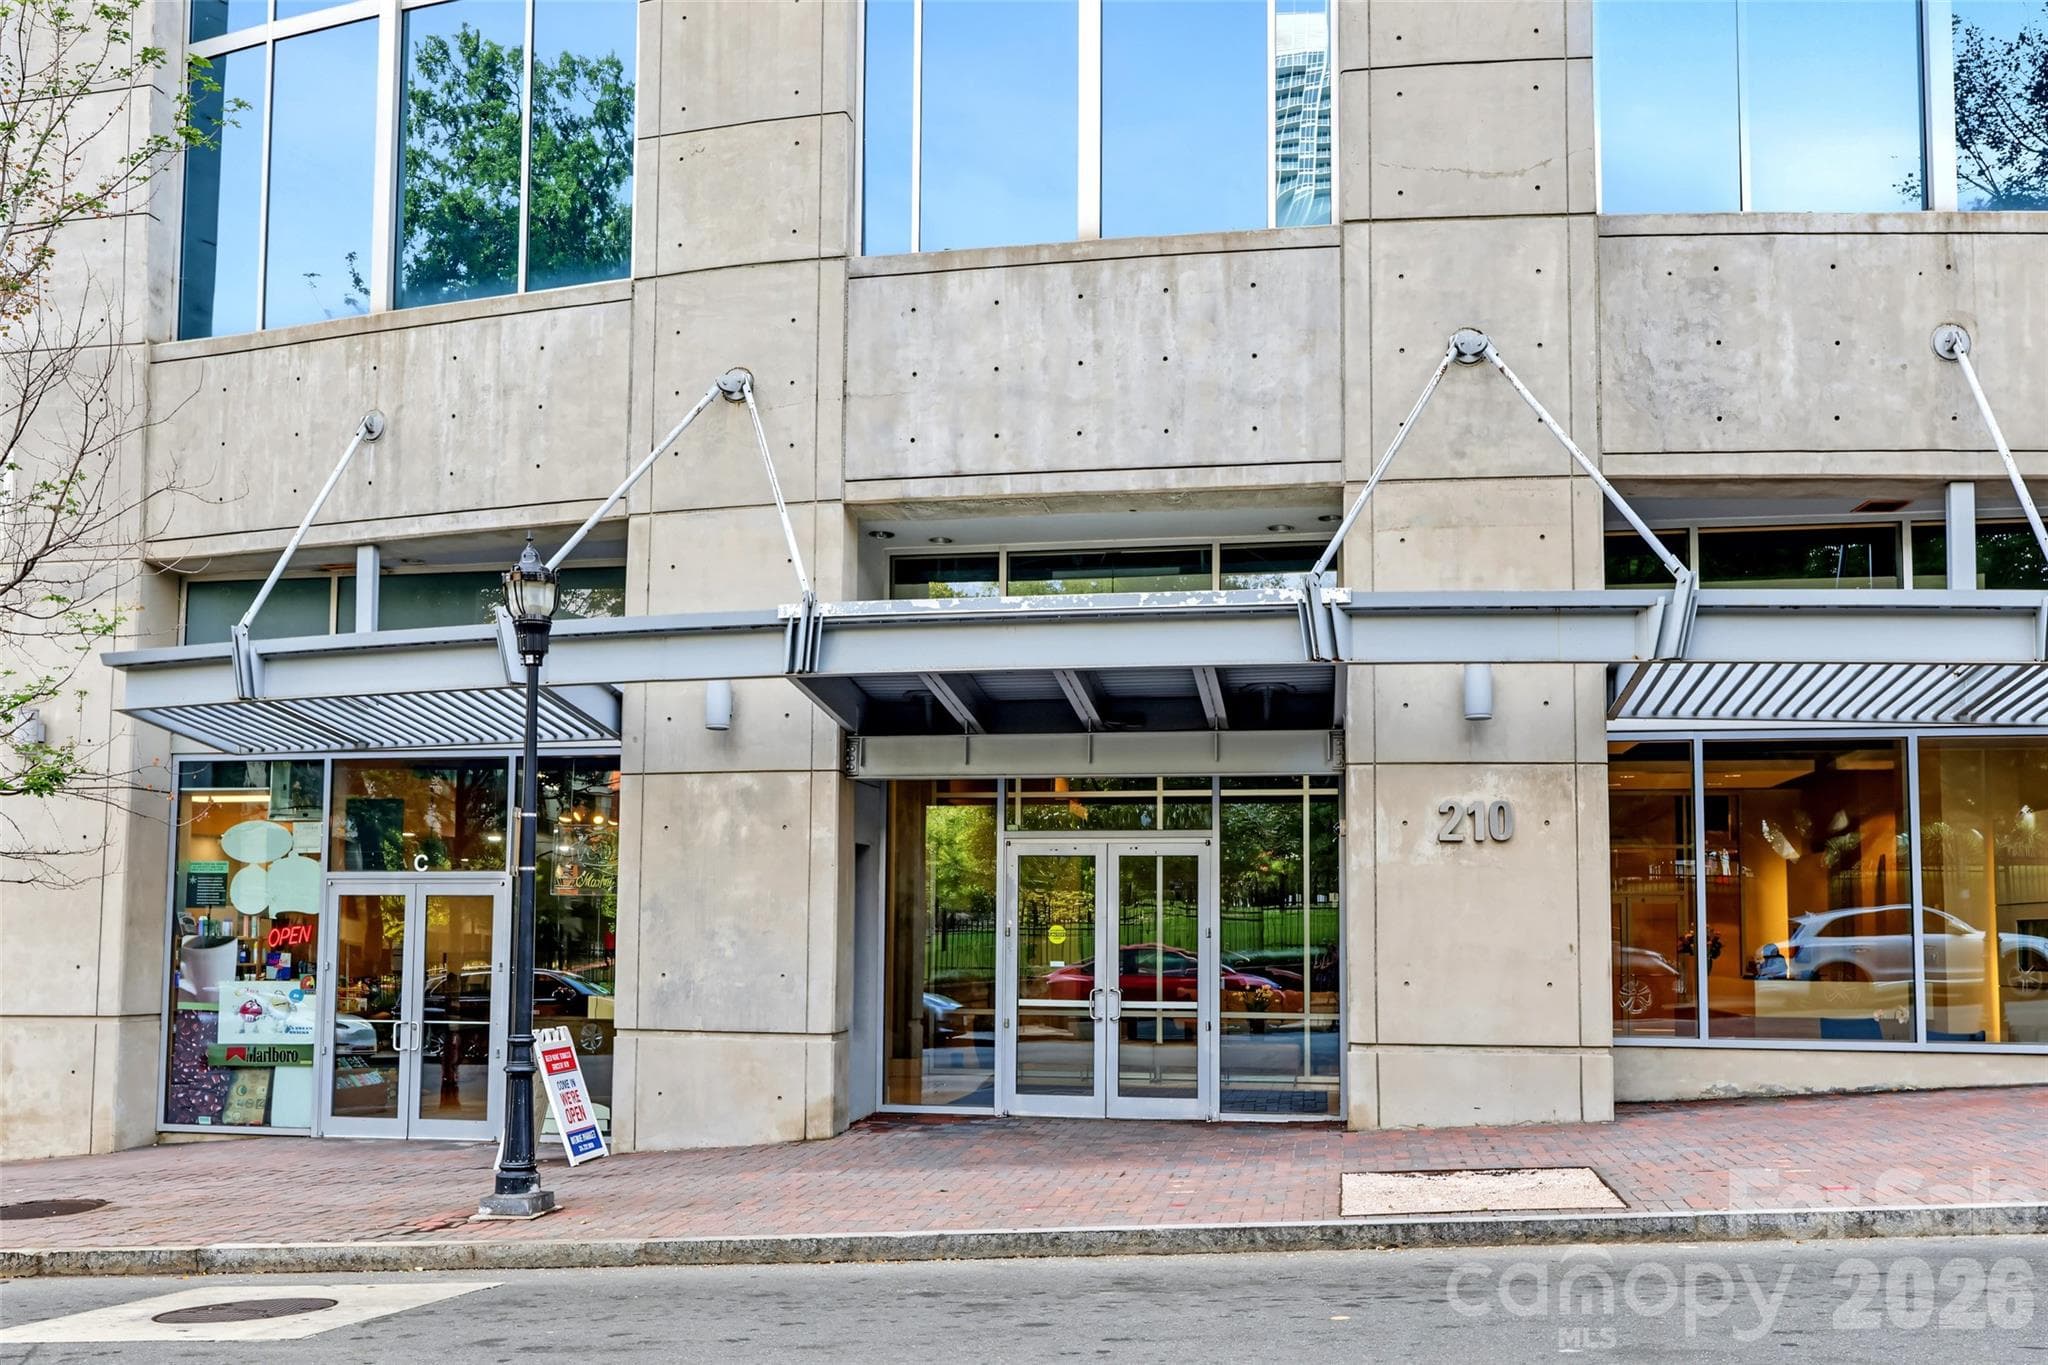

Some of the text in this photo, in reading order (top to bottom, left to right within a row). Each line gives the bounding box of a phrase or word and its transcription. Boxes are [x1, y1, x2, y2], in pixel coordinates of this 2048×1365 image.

[1438, 800, 1514, 843] 210
[414, 854, 429, 872] C
[268, 925, 312, 947] OPEN
[246, 1047, 299, 1063] Marlboro
[565, 1106, 586, 1124] OPEN
